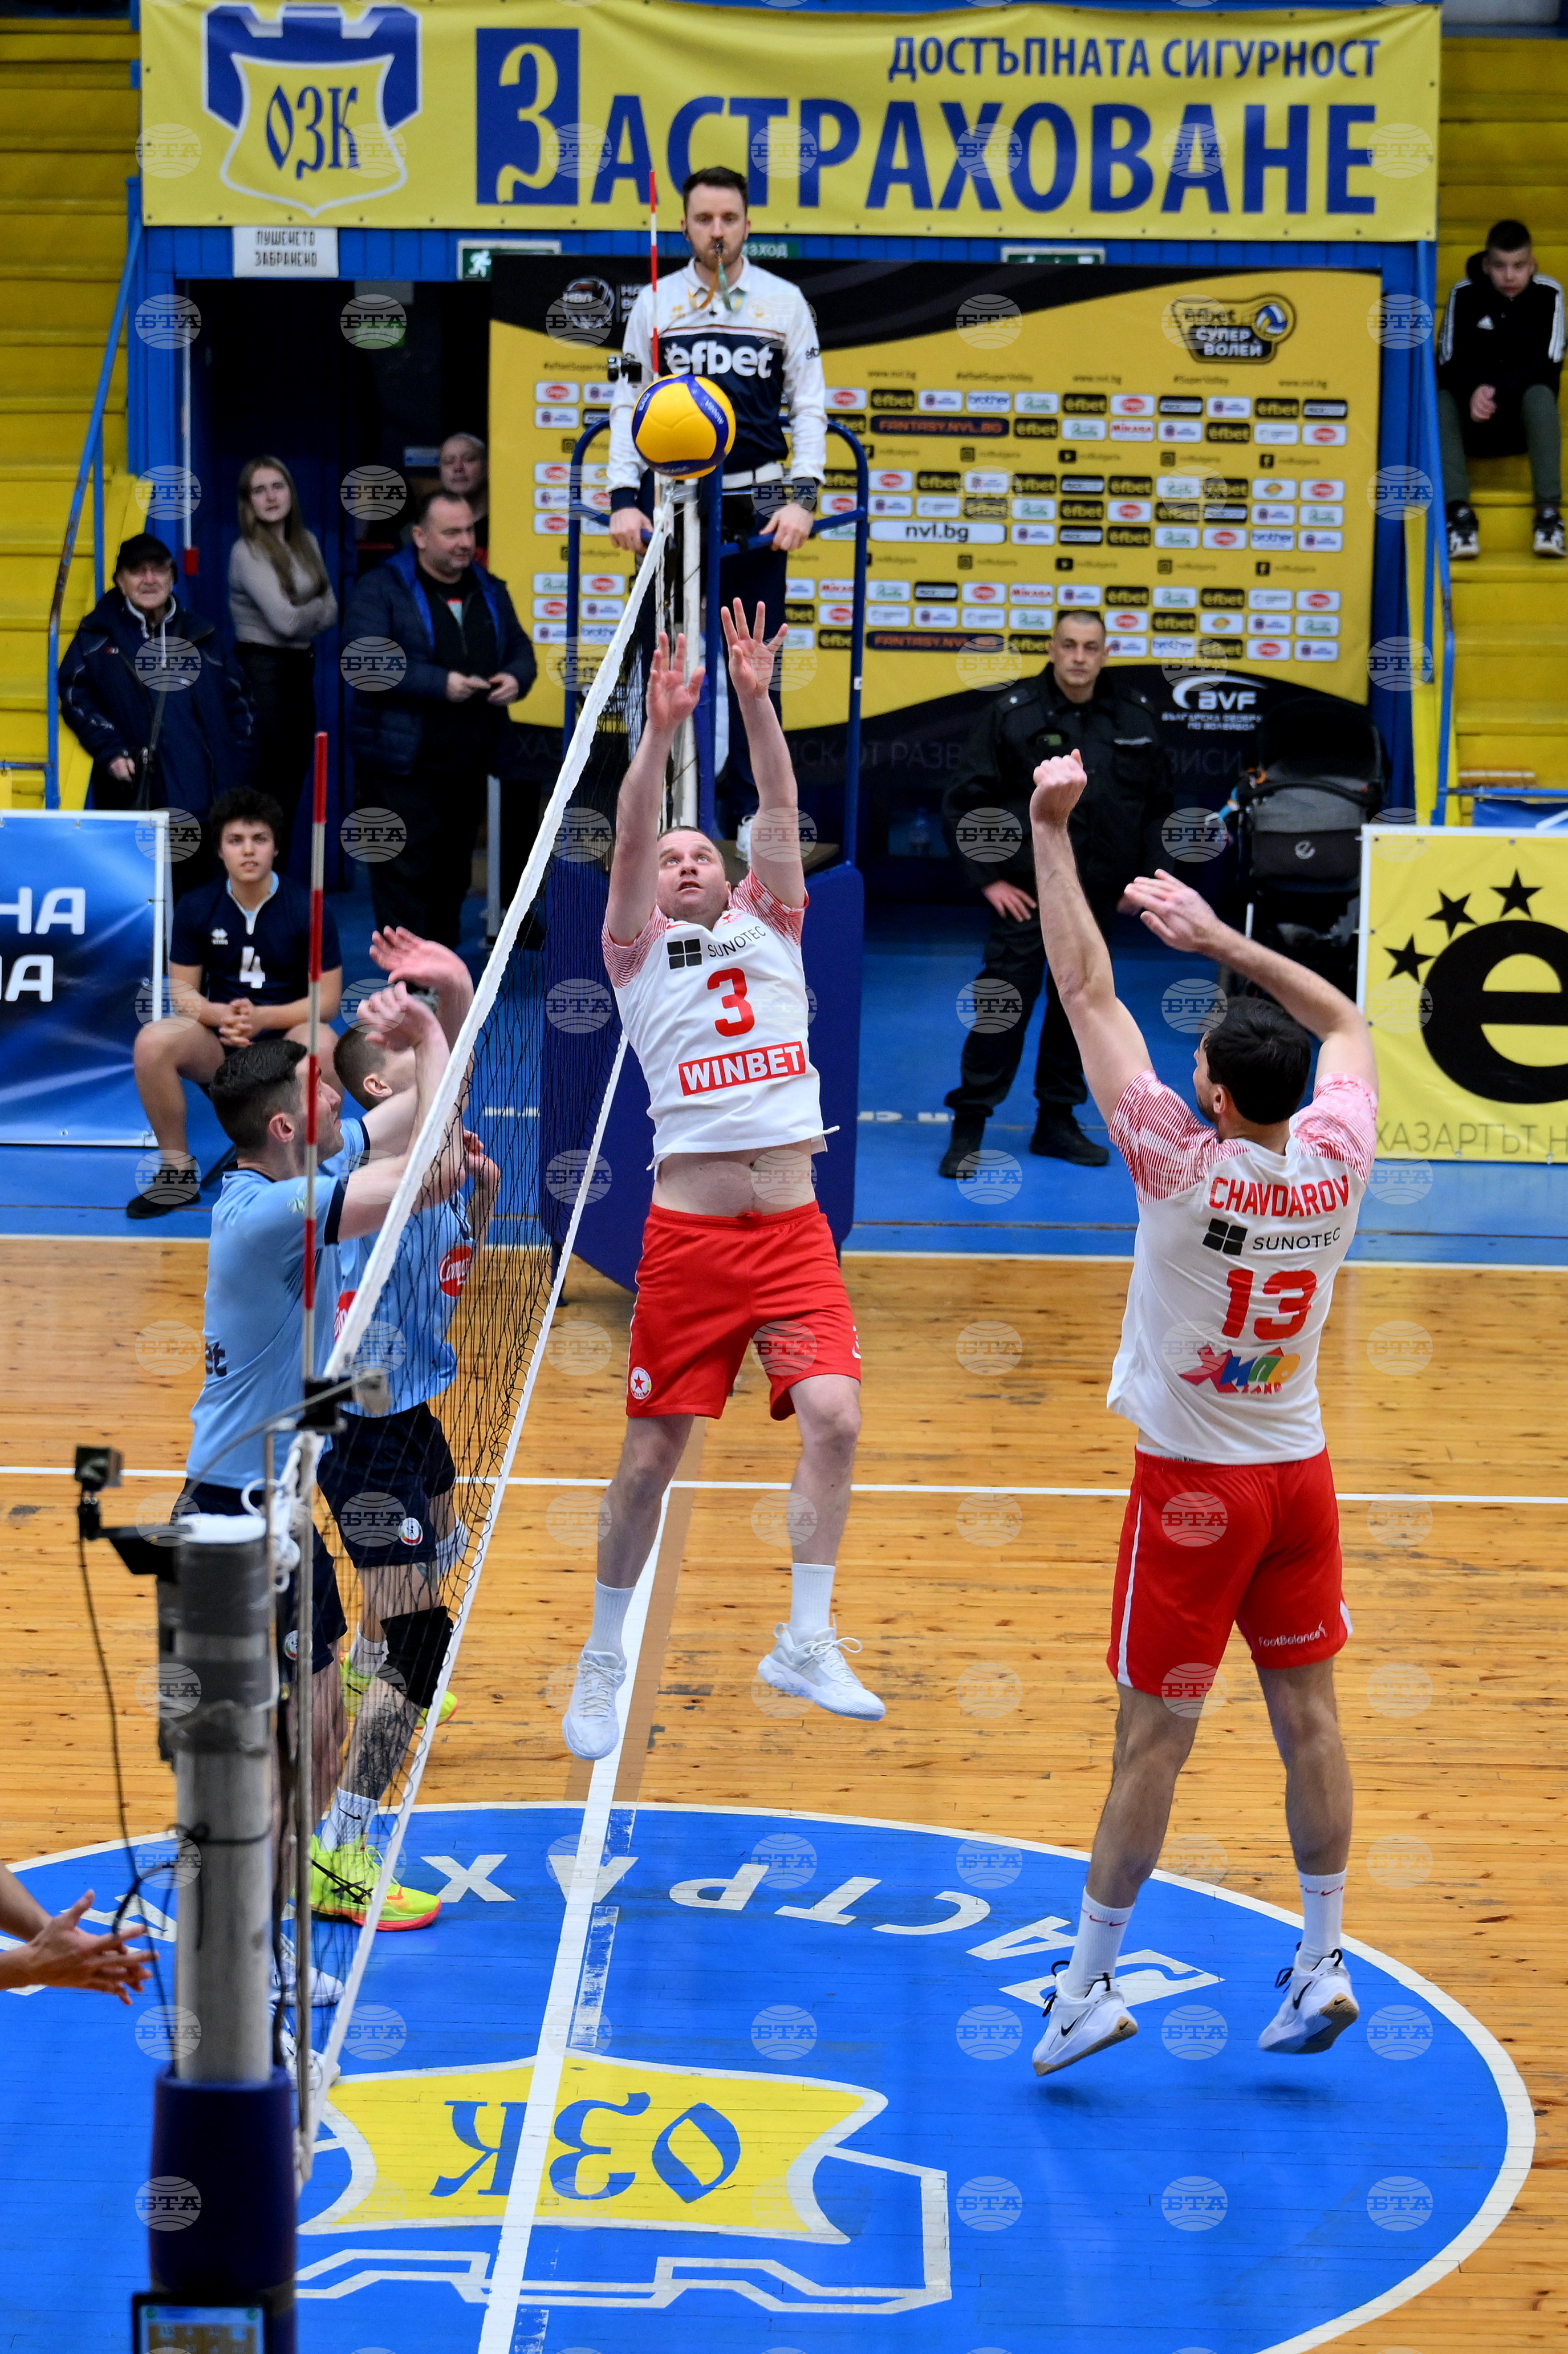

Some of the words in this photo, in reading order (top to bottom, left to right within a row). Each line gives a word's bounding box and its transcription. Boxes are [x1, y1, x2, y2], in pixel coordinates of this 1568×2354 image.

[888, 37, 1150, 82] ДОСТЪПНАТА
[1162, 39, 1380, 78] СИГУРНОСТ
[266, 84, 363, 181] ОЗК
[256, 229, 315, 247] ПУШЕНЕТО
[254, 250, 318, 268] ЗАБРАНЕНО
[1196, 327, 1252, 342] СУПЕР
[1204, 338, 1264, 356] ВОЛЕЙ
[667, 340, 774, 379] efbet
[1257, 402, 1298, 417] efbet
[1111, 480, 1152, 494] efbet
[905, 524, 969, 542] nvl.bg
[1109, 530, 1151, 545] efbet
[1251, 531, 1292, 543] brother
[708, 926, 767, 958] SUNOTEC
[239, 946, 266, 989] 4
[707, 968, 755, 1037] 3
[683, 1045, 801, 1091] WINBET
[1209, 1175, 1350, 1217] CHAVDAROV
[1253, 1227, 1340, 1251] SUNOTEC
[1221, 1268, 1318, 1341] 13
[1258, 1630, 1321, 1647] FootBalance
[430, 2092, 741, 2203] ОЗК
